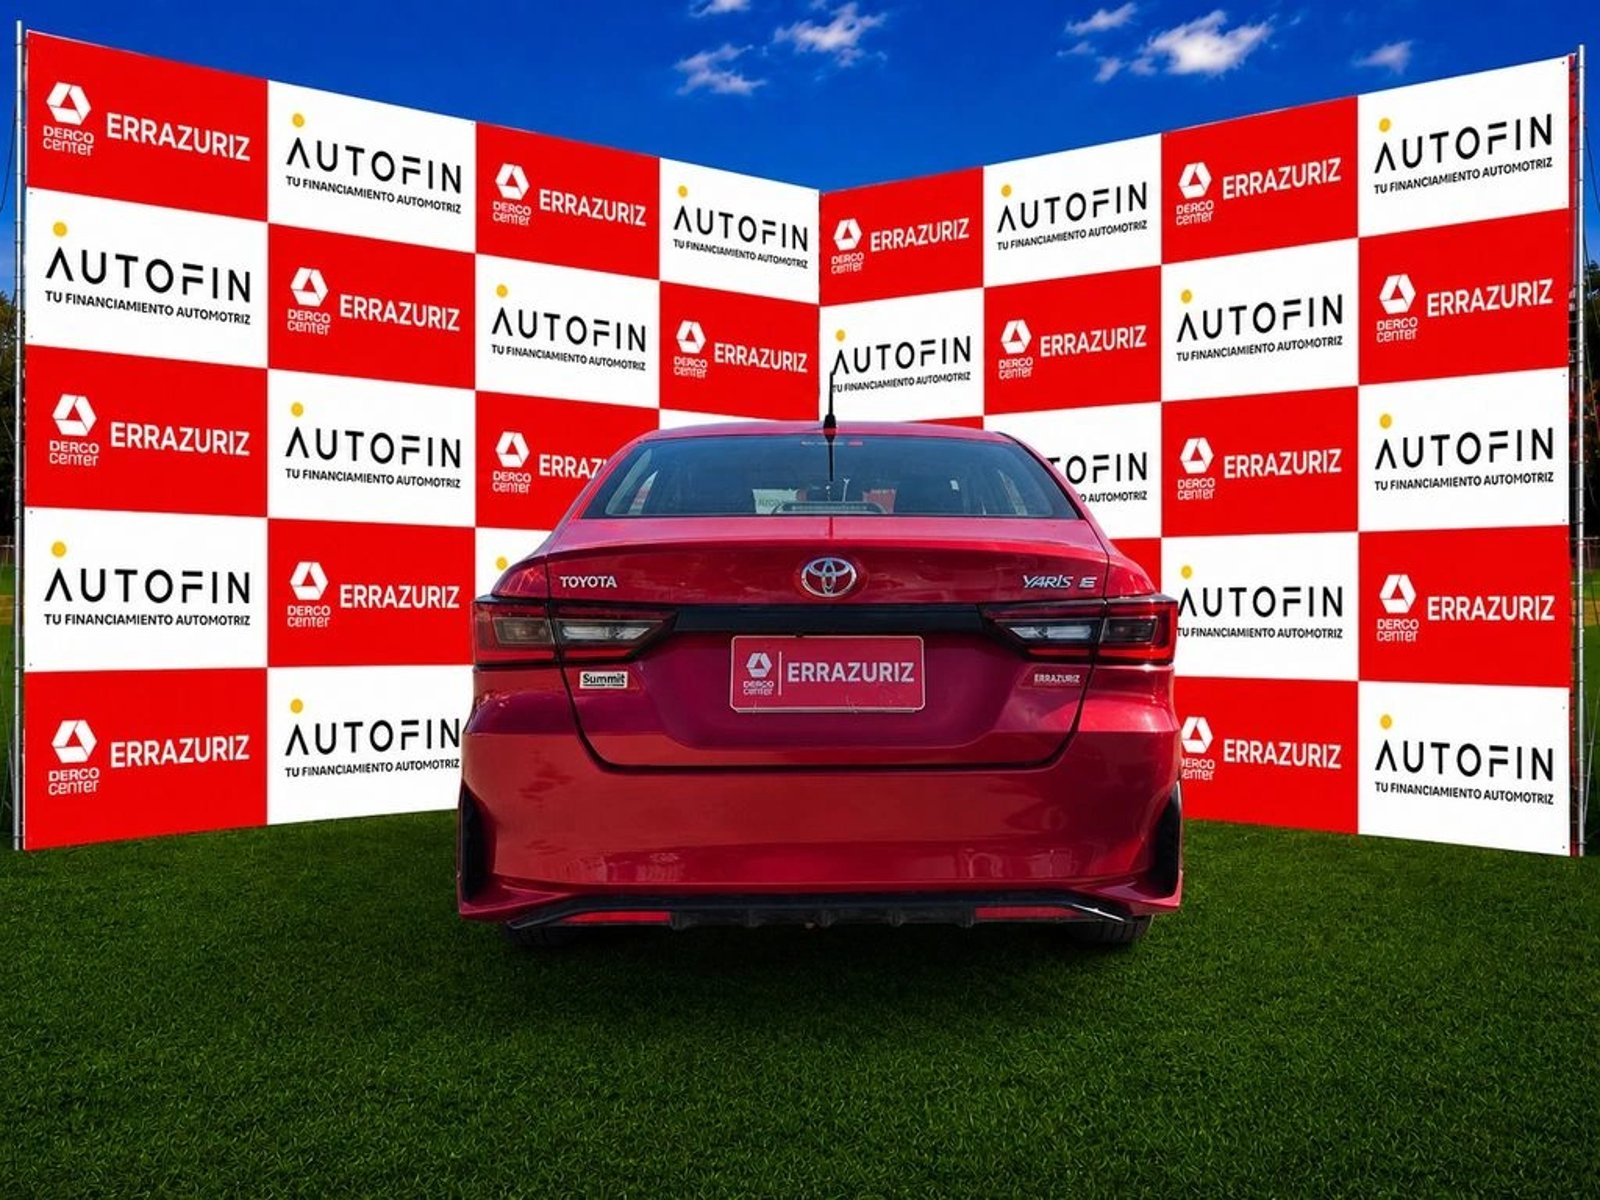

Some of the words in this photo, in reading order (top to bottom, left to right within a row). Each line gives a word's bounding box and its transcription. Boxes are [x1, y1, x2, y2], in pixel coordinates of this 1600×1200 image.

[43, 125, 95, 145] DERCO
[106, 112, 251, 162] ERRAZURIZ
[1374, 113, 1552, 174] AUTOFIN
[43, 137, 94, 156] center
[286, 137, 461, 194] AUTOFIN
[1374, 183, 1388, 194] TU
[1389, 168, 1481, 192] FINANCIAMIENTO
[1482, 156, 1553, 178] AUTOMOTRIZ
[1222, 157, 1341, 200] ERRAZURIZ
[286, 175, 301, 187] TU
[302, 178, 395, 203] FINANCIAMIENTO
[396, 194, 461, 214] AUTOMOTRIZ
[493, 201, 532, 216] DERCO
[539, 188, 646, 227] ERRAZURIZ
[997, 181, 1147, 234] AUTOFIN
[1176, 199, 1214, 215] DERCO
[493, 211, 530, 226] center
[1176, 210, 1213, 226] center
[673, 205, 808, 252] AUTOFIN
[870, 217, 970, 252] ERRAZURIZ
[997, 241, 1009, 250] TU
[1010, 229, 1087, 249] FINANCIAMIENTO
[1088, 219, 1148, 237] AUTOMOTRIZ
[673, 239, 684, 249] TU
[685, 241, 757, 260] FINANCIAMIENTO
[757, 253, 808, 269] AUTOMOTRIZ
[831, 252, 864, 265] DERCO
[45, 246, 251, 303] AUTOFIN
[831, 261, 863, 274] center
[44, 290, 63, 304] TU
[65, 292, 174, 316] FINANCIAMIENTO
[176, 306, 251, 326] AUTOMOTRIZ
[1427, 278, 1553, 318] ERRAZURIZ
[287, 309, 331, 324] DERCO
[339, 293, 460, 332] ERRAZURIZ
[1176, 293, 1343, 343] AUTOFIN
[287, 320, 330, 335] center
[491, 307, 646, 353] AUTOFIN
[1376, 316, 1418, 332] DERCO
[1040, 324, 1147, 358] ERRAZURIZ
[1376, 327, 1417, 343] center
[491, 344, 505, 355] TU
[506, 346, 588, 365] FINANCIAMIENTO
[588, 356, 646, 371] AUTOMOTRIZ
[714, 342, 807, 373] ERRAZURIZ
[830, 335, 971, 375] AUTOFIN
[1176, 352, 1190, 362] TU
[1190, 342, 1276, 360] FINANCIAMIENTO
[1276, 335, 1343, 351] AUTOMOTRIZ
[674, 356, 708, 369] DERCO
[674, 366, 707, 378] center
[998, 356, 1034, 370] DERCO
[844, 376, 915, 391] FINANCIAMIENTO
[916, 371, 971, 385] AUTOMOTRIZ
[999, 366, 1032, 380] center
[49, 440, 100, 455] DERCO
[110, 421, 250, 456] ERRAZURIZ
[285, 426, 461, 469] AUTOFIN
[1374, 427, 1554, 470] AUTOFIN
[49, 452, 99, 466] center
[538, 453, 607, 479] ERRAZ
[1224, 448, 1342, 479] ERRAZURIZ
[285, 468, 300, 479] TU
[302, 469, 395, 485] FINANCIAMIENTO
[396, 475, 461, 489] AUTOMOTRIZ
[492, 470, 532, 484] DERCO
[492, 481, 530, 493] center
[1177, 477, 1215, 490] DERCO
[1374, 480, 1388, 491] TU
[1390, 475, 1482, 490] FINANCIAMIENTO
[1483, 471, 1554, 486] AUTOMOTRIZ
[1088, 491, 1148, 502] AUTOMOTRIZ
[1177, 488, 1215, 501] center
[44, 567, 250, 604] AUTOFIN
[560, 575, 618, 588] TOYOTA
[1022, 574, 1074, 588] YARIS
[1078, 576, 1097, 588] E
[340, 584, 460, 609] ERRAZURIZ
[1178, 586, 1343, 618] AUTOFIN
[287, 605, 331, 617] DERCO
[1427, 595, 1555, 621] ERRAZURIZ
[44, 613, 62, 626] TU
[64, 613, 174, 626] FINANCIAMIENTO
[175, 614, 251, 626] AUTOMOTRIZ
[287, 616, 330, 628] center
[1377, 618, 1419, 631] DERCO
[1176, 627, 1190, 637] TU
[1190, 627, 1276, 639] FINANCIAMIENTO
[1277, 627, 1343, 639] AUTOMOTRIZ
[1377, 629, 1418, 642] center
[582, 673, 626, 684] Summit
[787, 662, 914, 683] ERRAZURIZ
[1033, 673, 1080, 683] ERRAZURIZ
[285, 718, 460, 757] AUTOFIN
[110, 734, 250, 768] ERRAZURIZ
[1223, 738, 1342, 769] ERRAZURIZ
[1374, 739, 1553, 782] AUTOFIN
[48, 767, 100, 782] DERCO
[285, 767, 300, 778] TU
[301, 761, 394, 776] FINANCIAMIENTO
[395, 758, 461, 772] AUTOMOTRIZ
[1181, 768, 1214, 781] enter
[48, 779, 99, 796] center
[1375, 781, 1389, 793] TU
[1390, 782, 1482, 800] FINANCIAMIENTO
[1483, 789, 1554, 806] AUTOMOTRIZ
